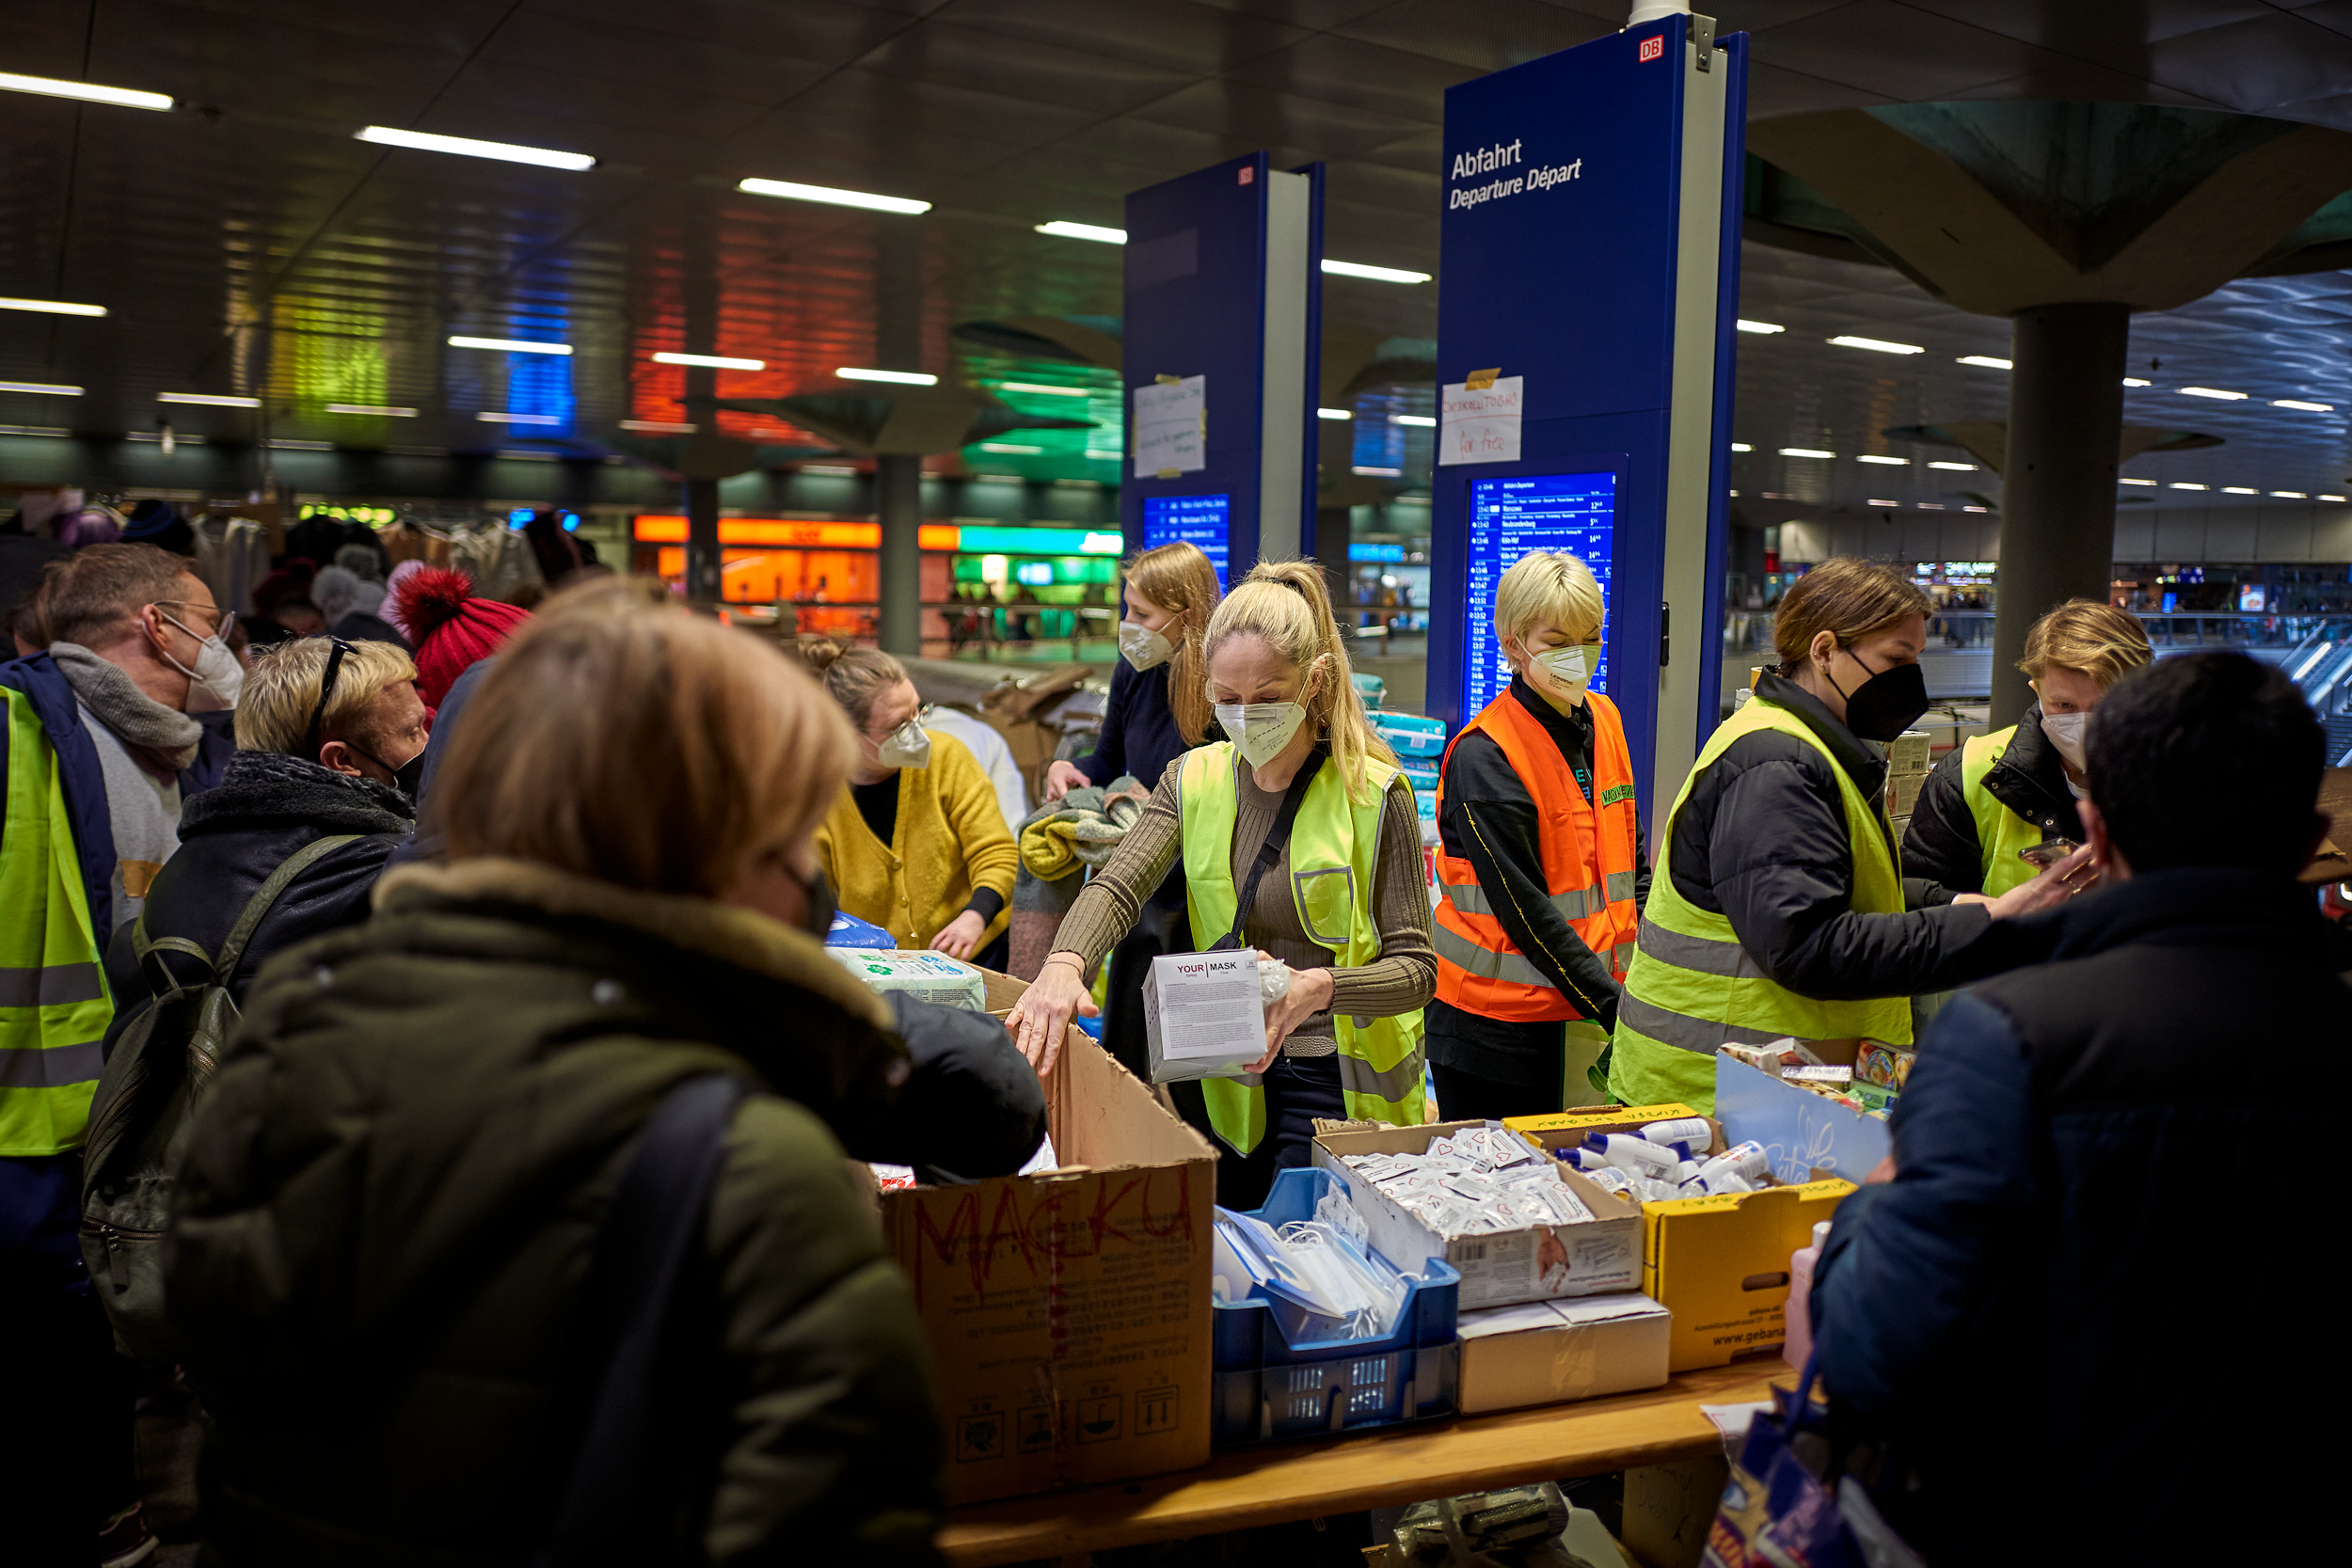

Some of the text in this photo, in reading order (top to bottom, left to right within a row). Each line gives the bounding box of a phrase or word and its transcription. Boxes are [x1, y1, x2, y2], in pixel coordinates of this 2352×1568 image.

[1640, 37, 1662, 61] DB
[1452, 139, 1521, 180] Abfahrt
[1450, 158, 1581, 210] Departure Départ
[1460, 428, 1504, 461] for free
[1177, 961, 1237, 974] YOUR MASK
